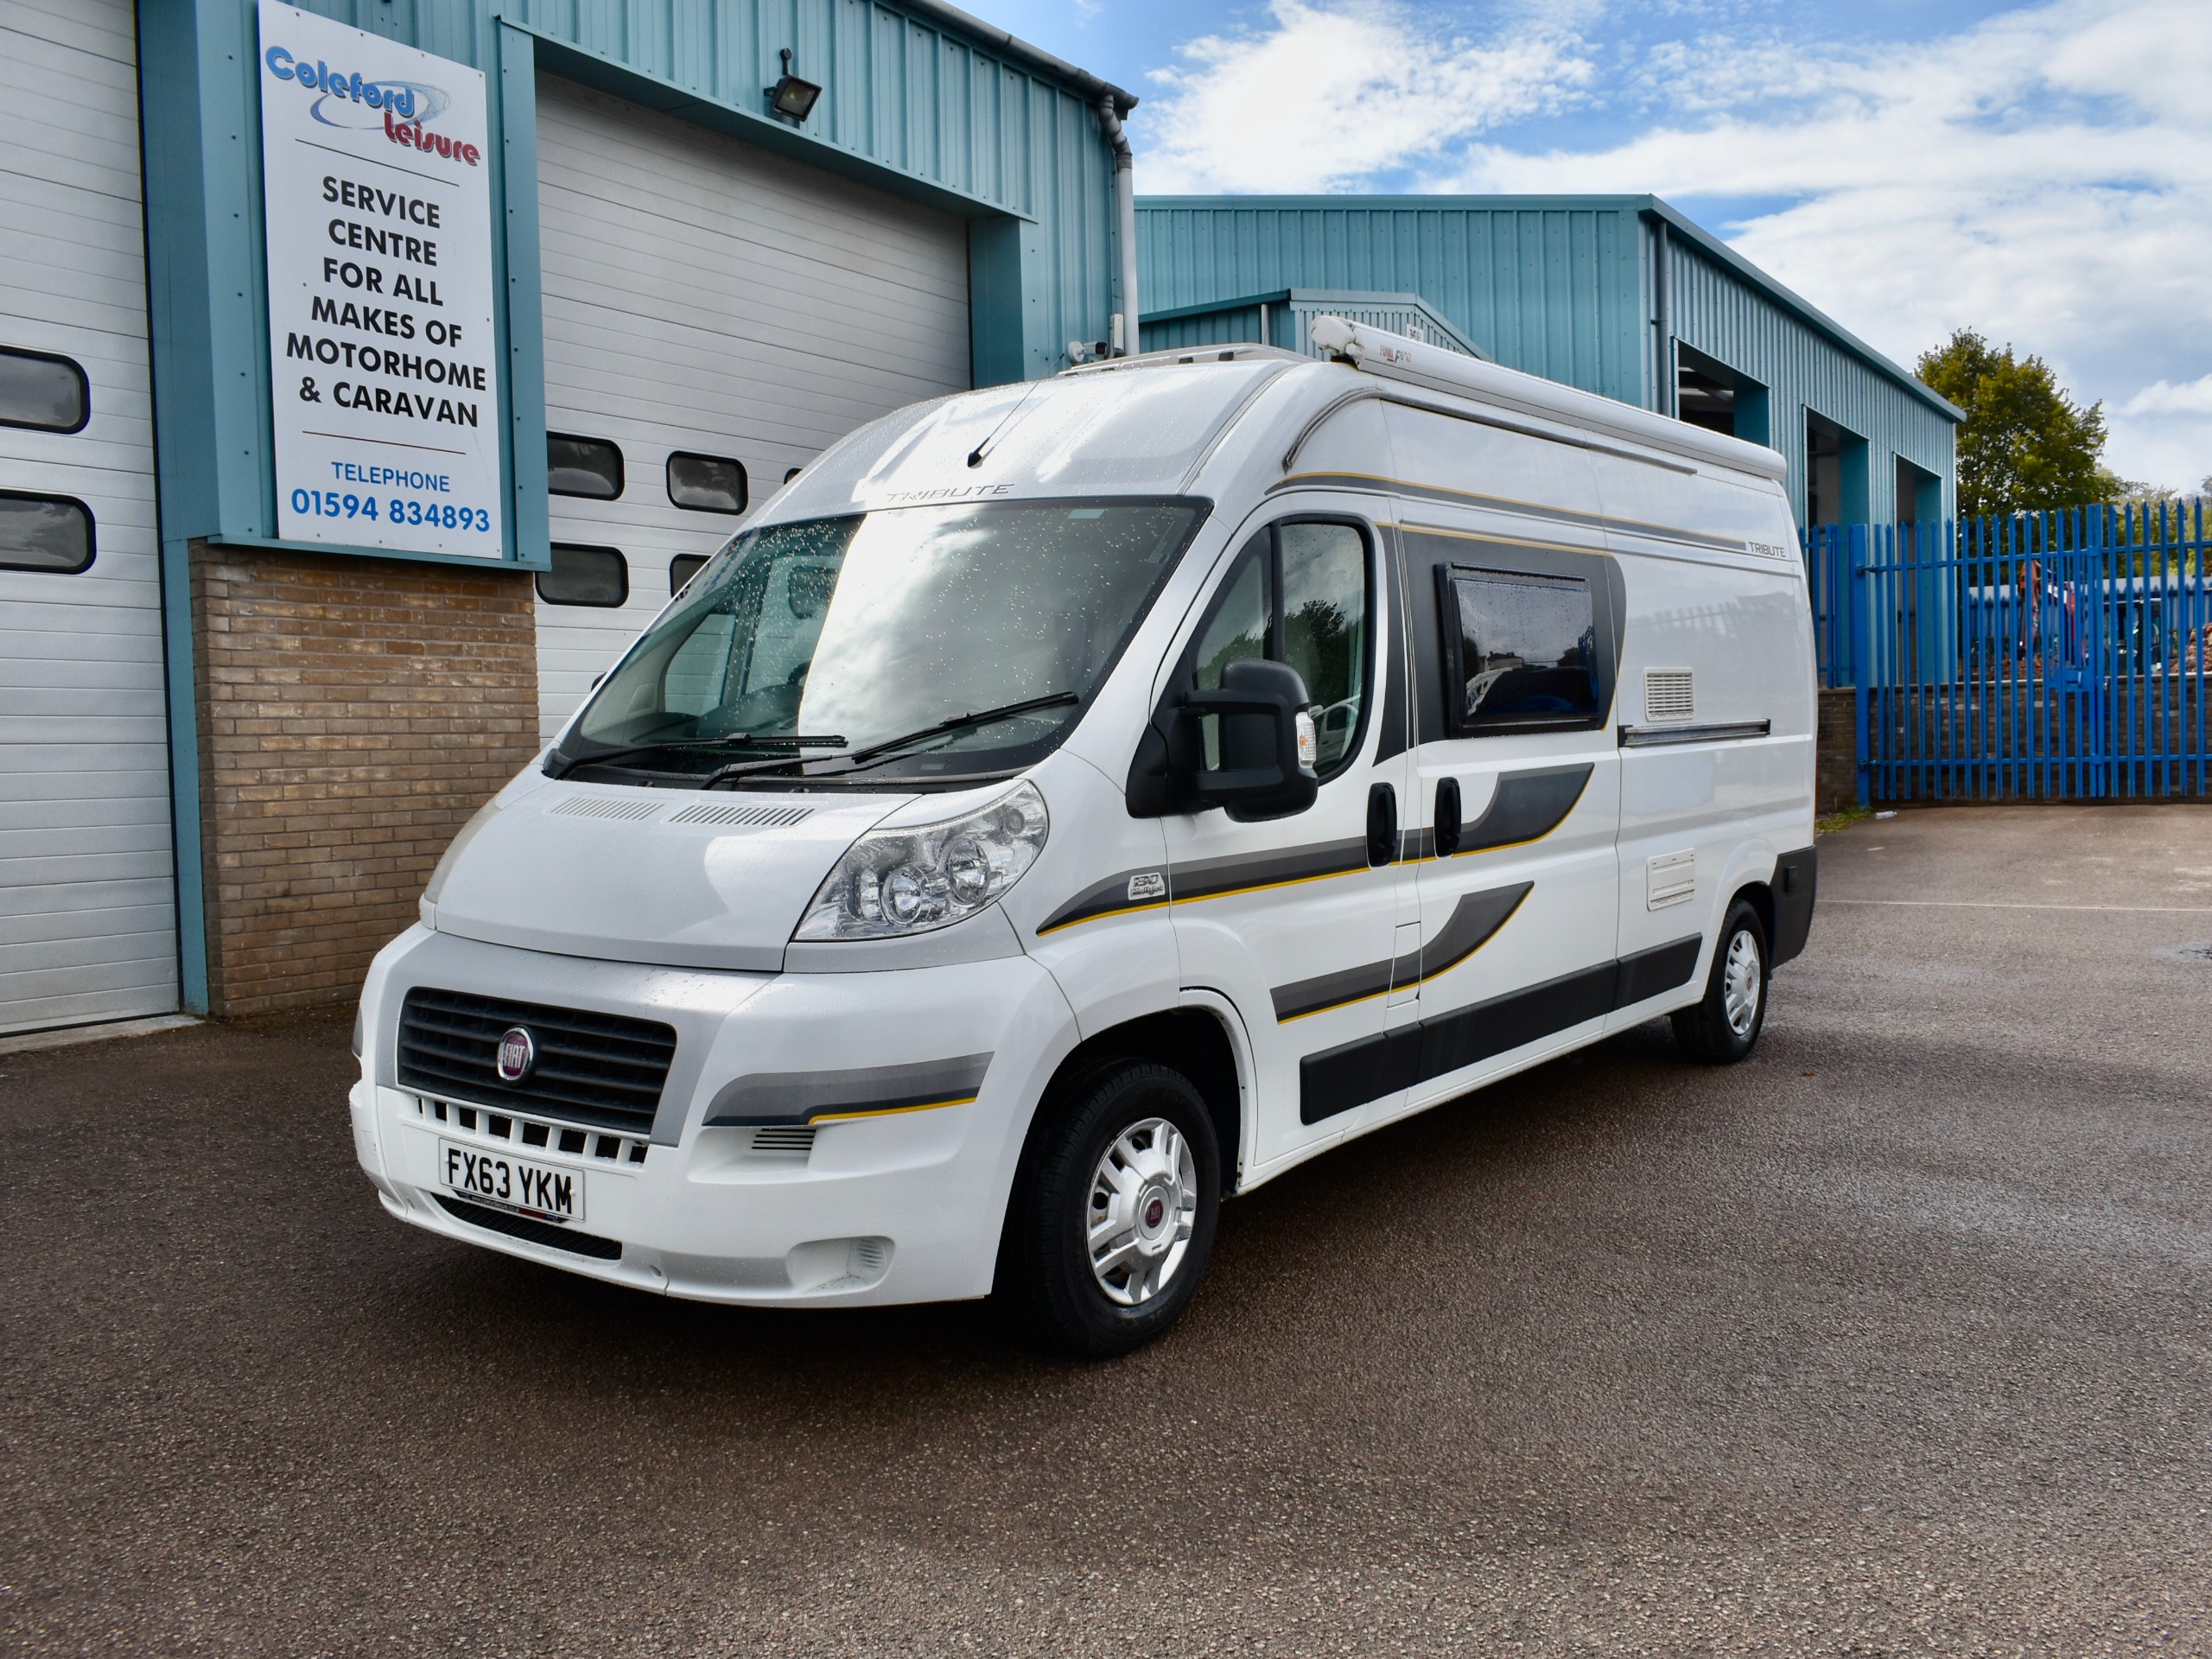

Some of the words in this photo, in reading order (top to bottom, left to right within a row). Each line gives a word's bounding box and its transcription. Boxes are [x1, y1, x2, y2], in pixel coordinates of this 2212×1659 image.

[265, 46, 415, 118] Coleford
[322, 175, 441, 229] SERVICE
[328, 219, 437, 267] CENTRE
[323, 257, 383, 294] FOR
[392, 273, 443, 307] ALL
[311, 296, 416, 340] MAKES
[425, 320, 462, 347] OF
[286, 332, 486, 391] MOTORHOME
[299, 376, 322, 404] &
[333, 381, 478, 428] CARAVAN
[331, 461, 451, 493] TELEPHONE
[887, 483, 1015, 503] TRIBUTE
[291, 488, 379, 521] 01594
[390, 499, 491, 532] 834893
[1749, 542, 1786, 557] TRIBUTE
[504, 1043, 525, 1068] FIAT
[448, 1147, 511, 1199] FX63
[518, 1166, 572, 1215] YKM
